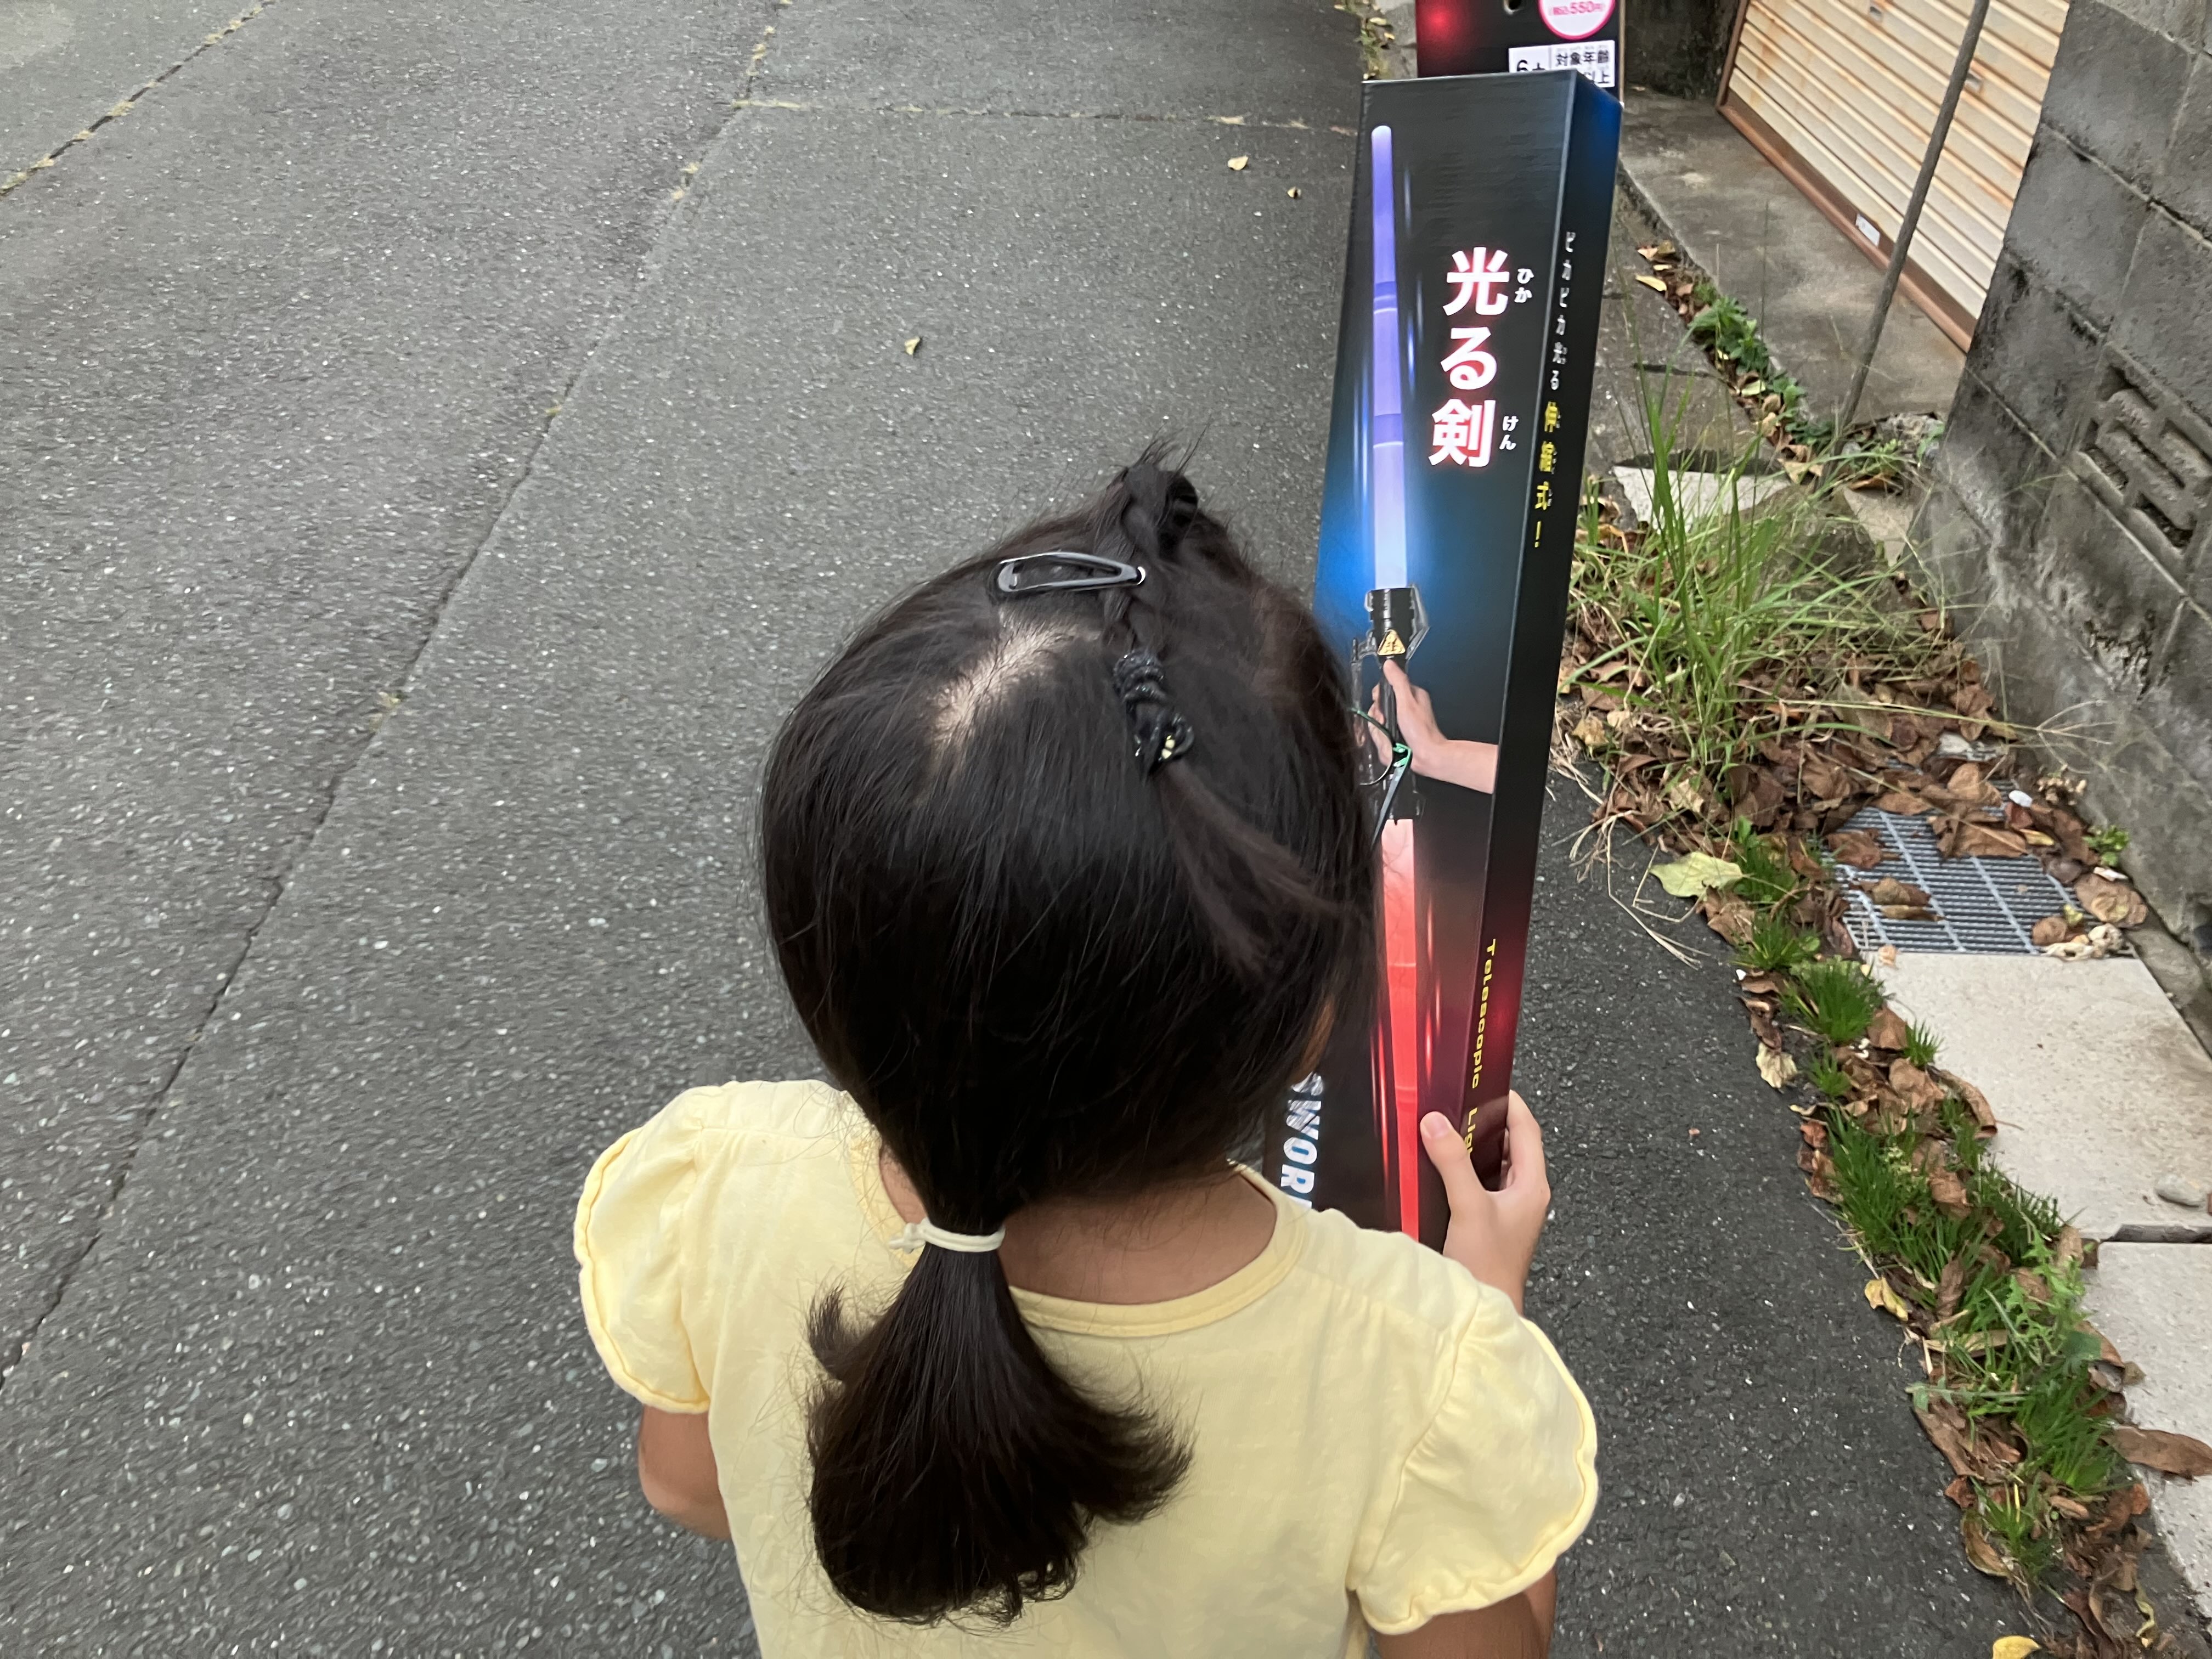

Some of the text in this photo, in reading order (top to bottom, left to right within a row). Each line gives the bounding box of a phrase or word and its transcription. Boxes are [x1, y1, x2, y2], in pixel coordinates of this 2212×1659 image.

[1513, 268, 1534, 304] ひか
[1428, 246, 1510, 467] 光る剣
[1499, 415, 1519, 450] けん
[1472, 938, 1496, 1088] Telescopic
